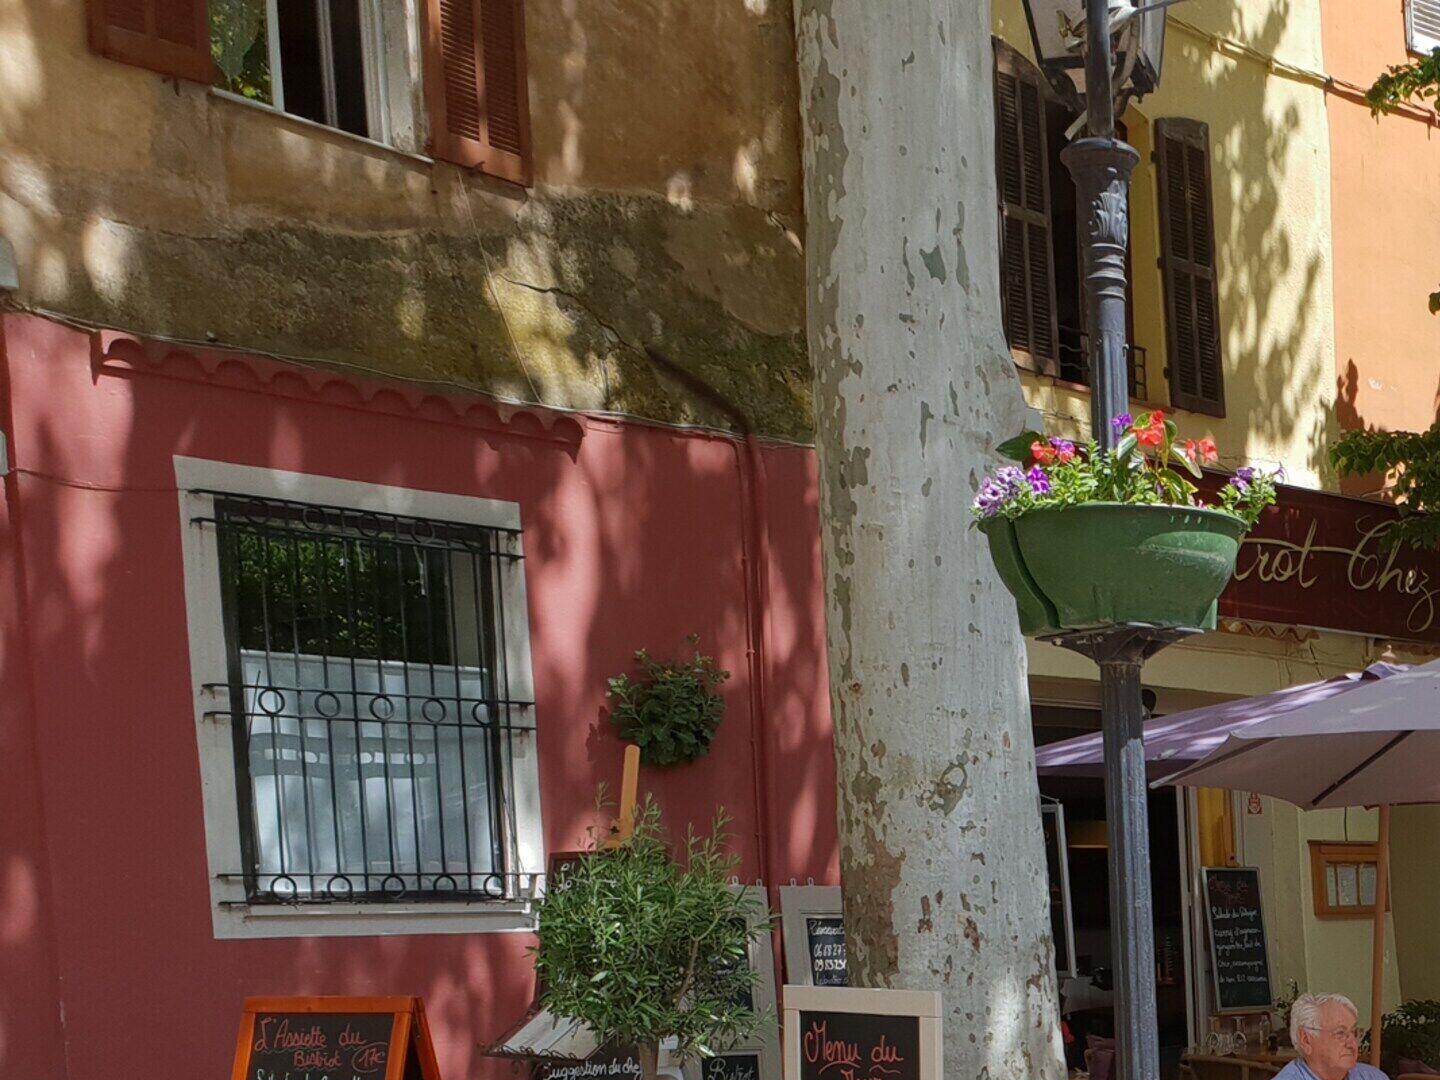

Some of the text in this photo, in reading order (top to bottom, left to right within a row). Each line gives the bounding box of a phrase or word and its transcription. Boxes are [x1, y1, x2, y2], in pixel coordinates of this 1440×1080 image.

[338, 1024, 367, 1045] du
[804, 1019, 905, 1063] Menu du
[293, 1051, 342, 1068] Bistrot
[608, 1057, 621, 1076] du
